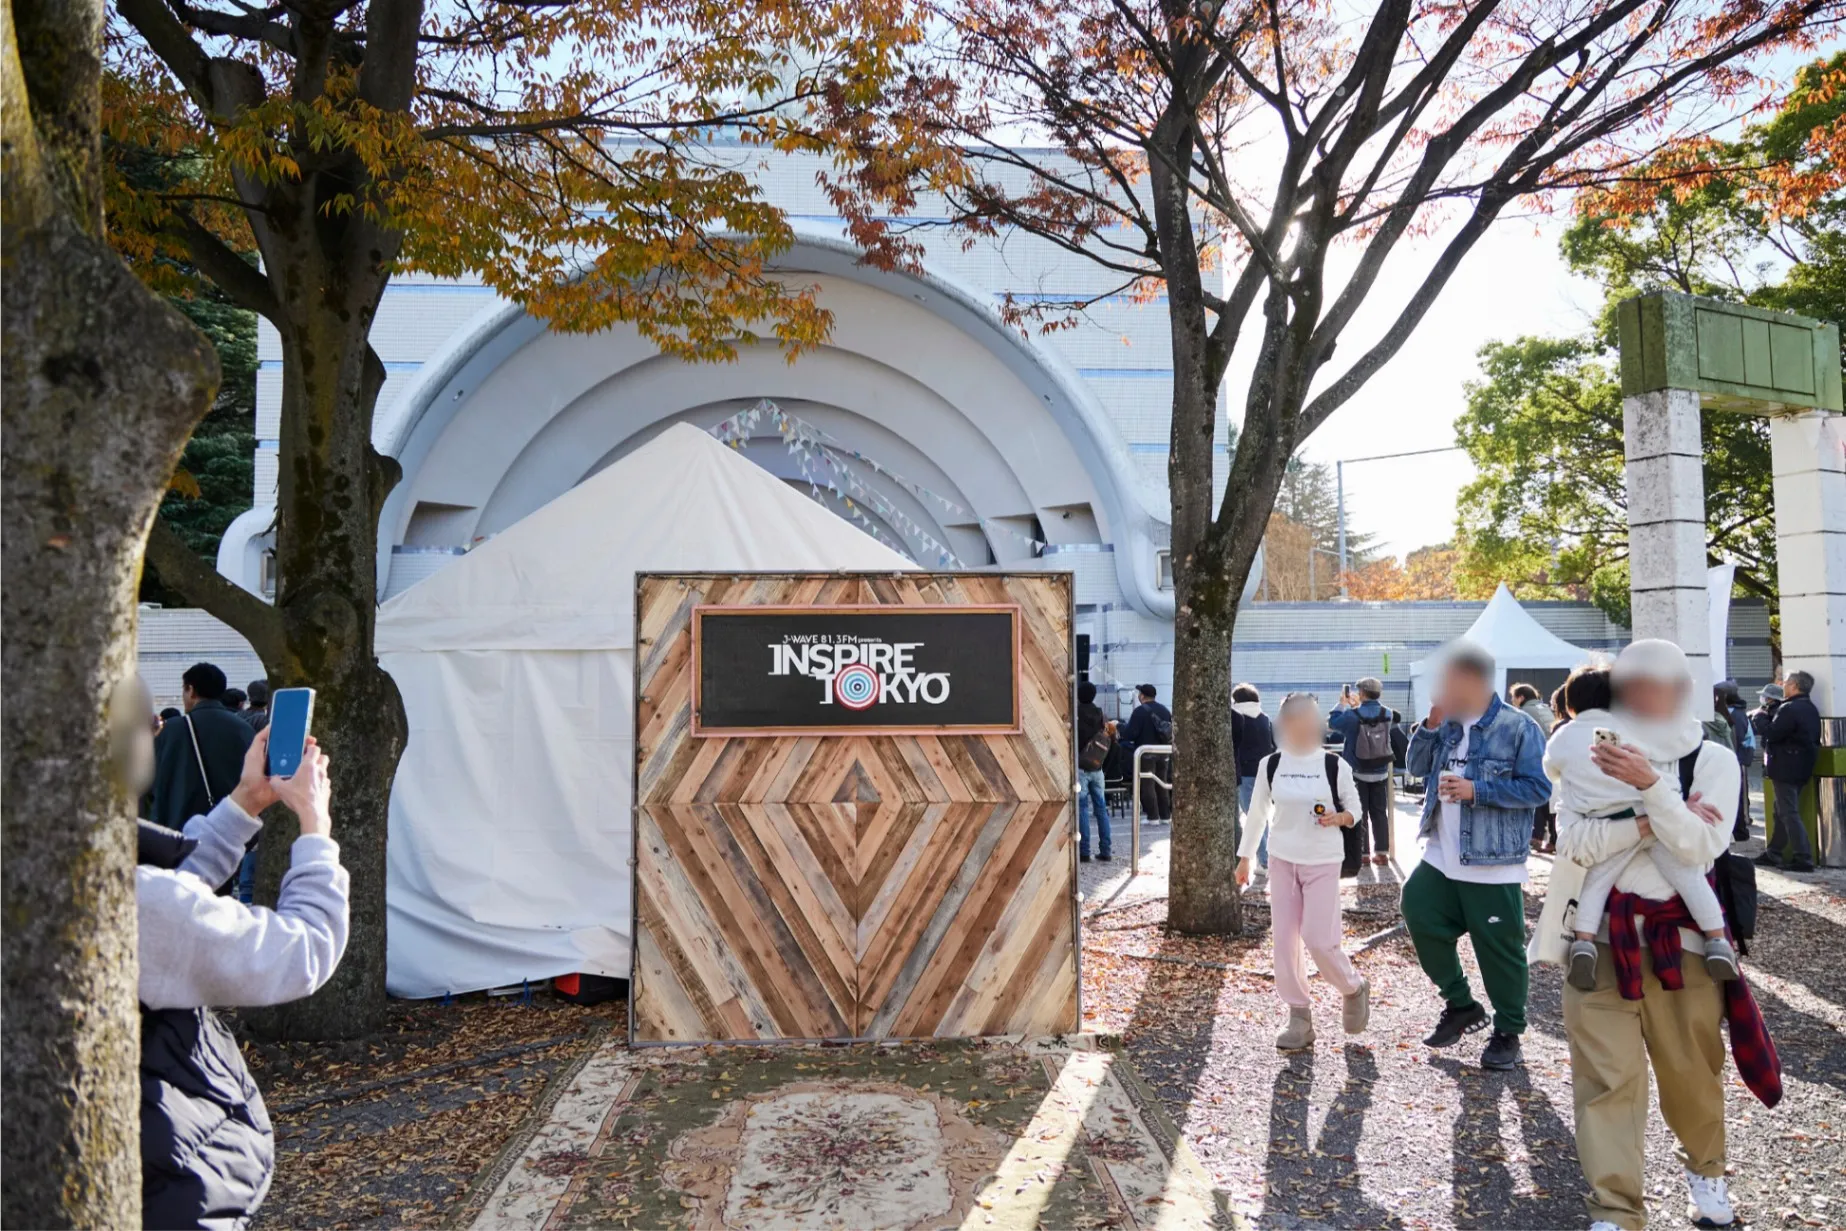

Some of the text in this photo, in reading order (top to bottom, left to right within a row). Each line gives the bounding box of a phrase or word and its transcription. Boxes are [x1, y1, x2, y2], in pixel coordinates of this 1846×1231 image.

[782, 634, 818, 644] J-WAVE
[820, 634, 858, 644] 81.3FM
[768, 642, 925, 676] INSPIRE
[808, 663, 951, 711] TOKYO
